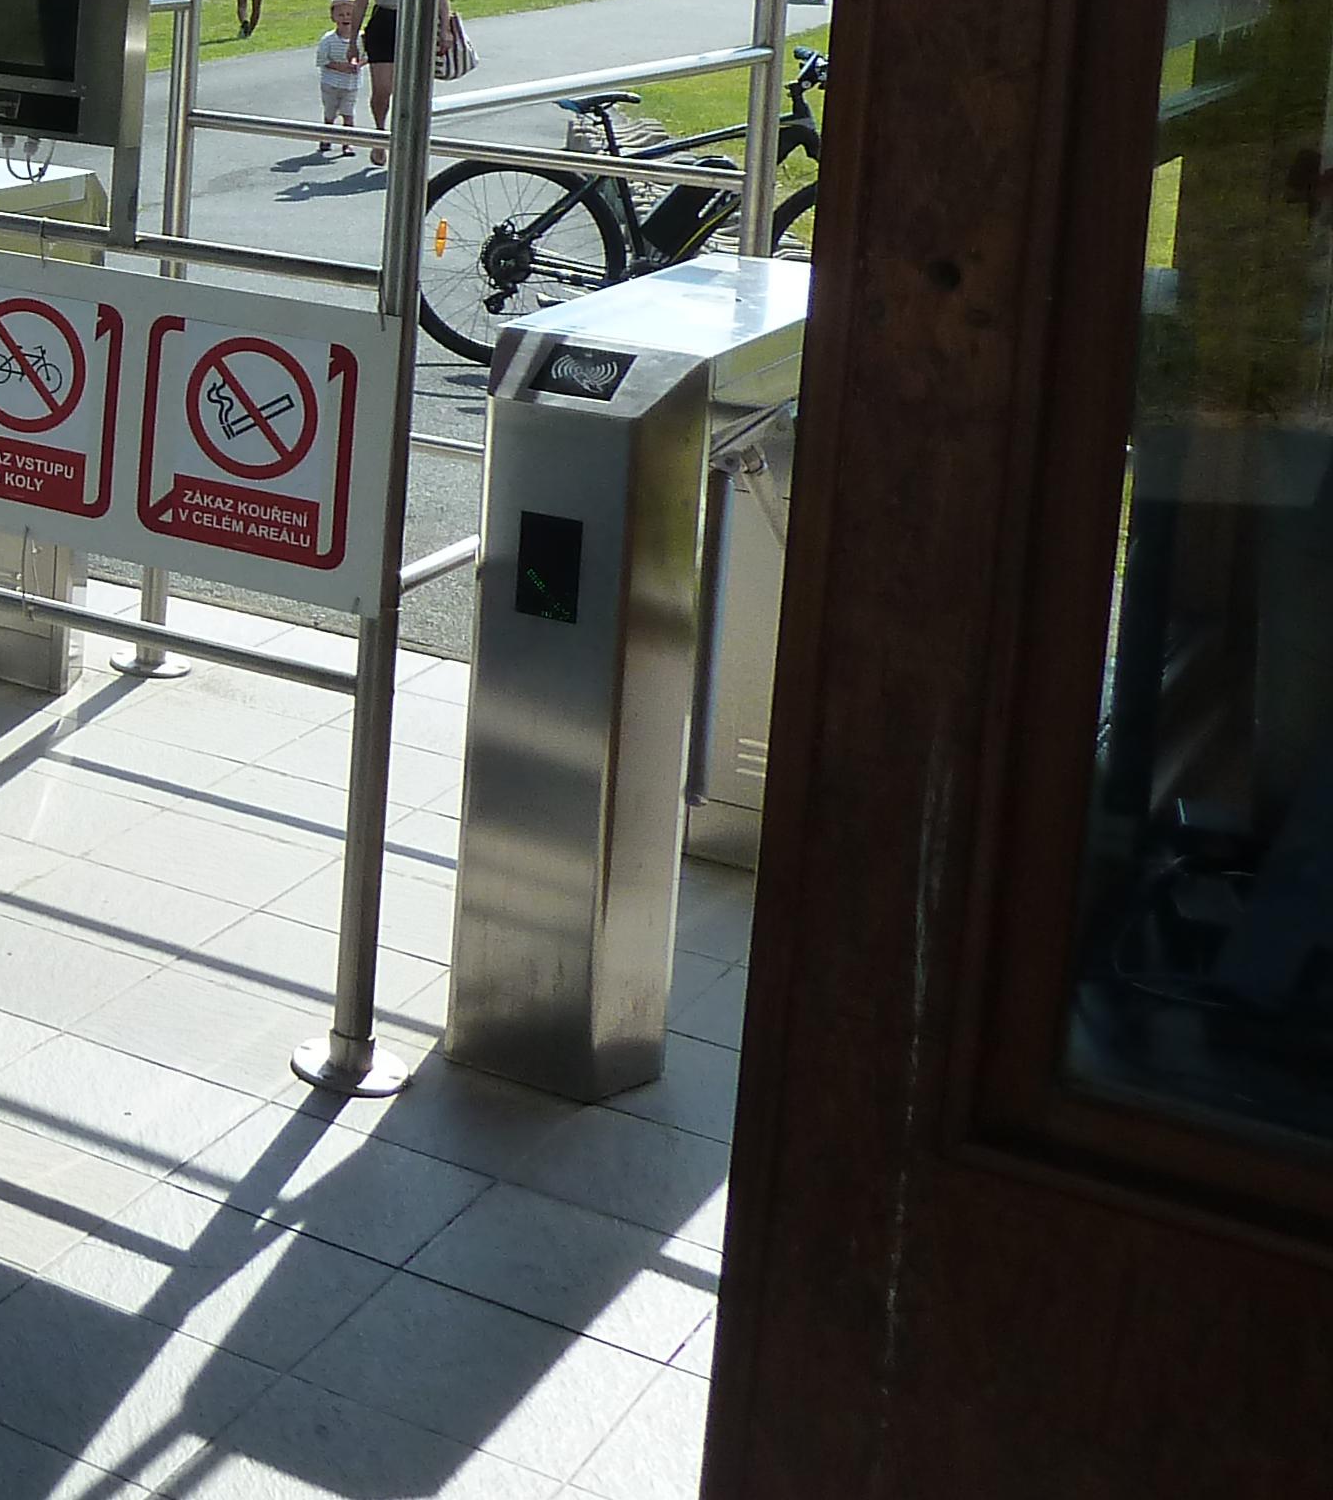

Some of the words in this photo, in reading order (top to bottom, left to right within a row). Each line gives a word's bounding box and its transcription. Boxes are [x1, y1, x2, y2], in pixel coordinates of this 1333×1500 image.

[4, 472, 44, 492] KOLY
[15, 454, 74, 479] VSTUPU
[183, 489, 234, 512] ZÁKAZ
[237, 501, 309, 528] KOUŘENÍ
[178, 508, 189, 521] V
[192, 511, 244, 534] CELÉM
[247, 523, 311, 548] AREÁLU
